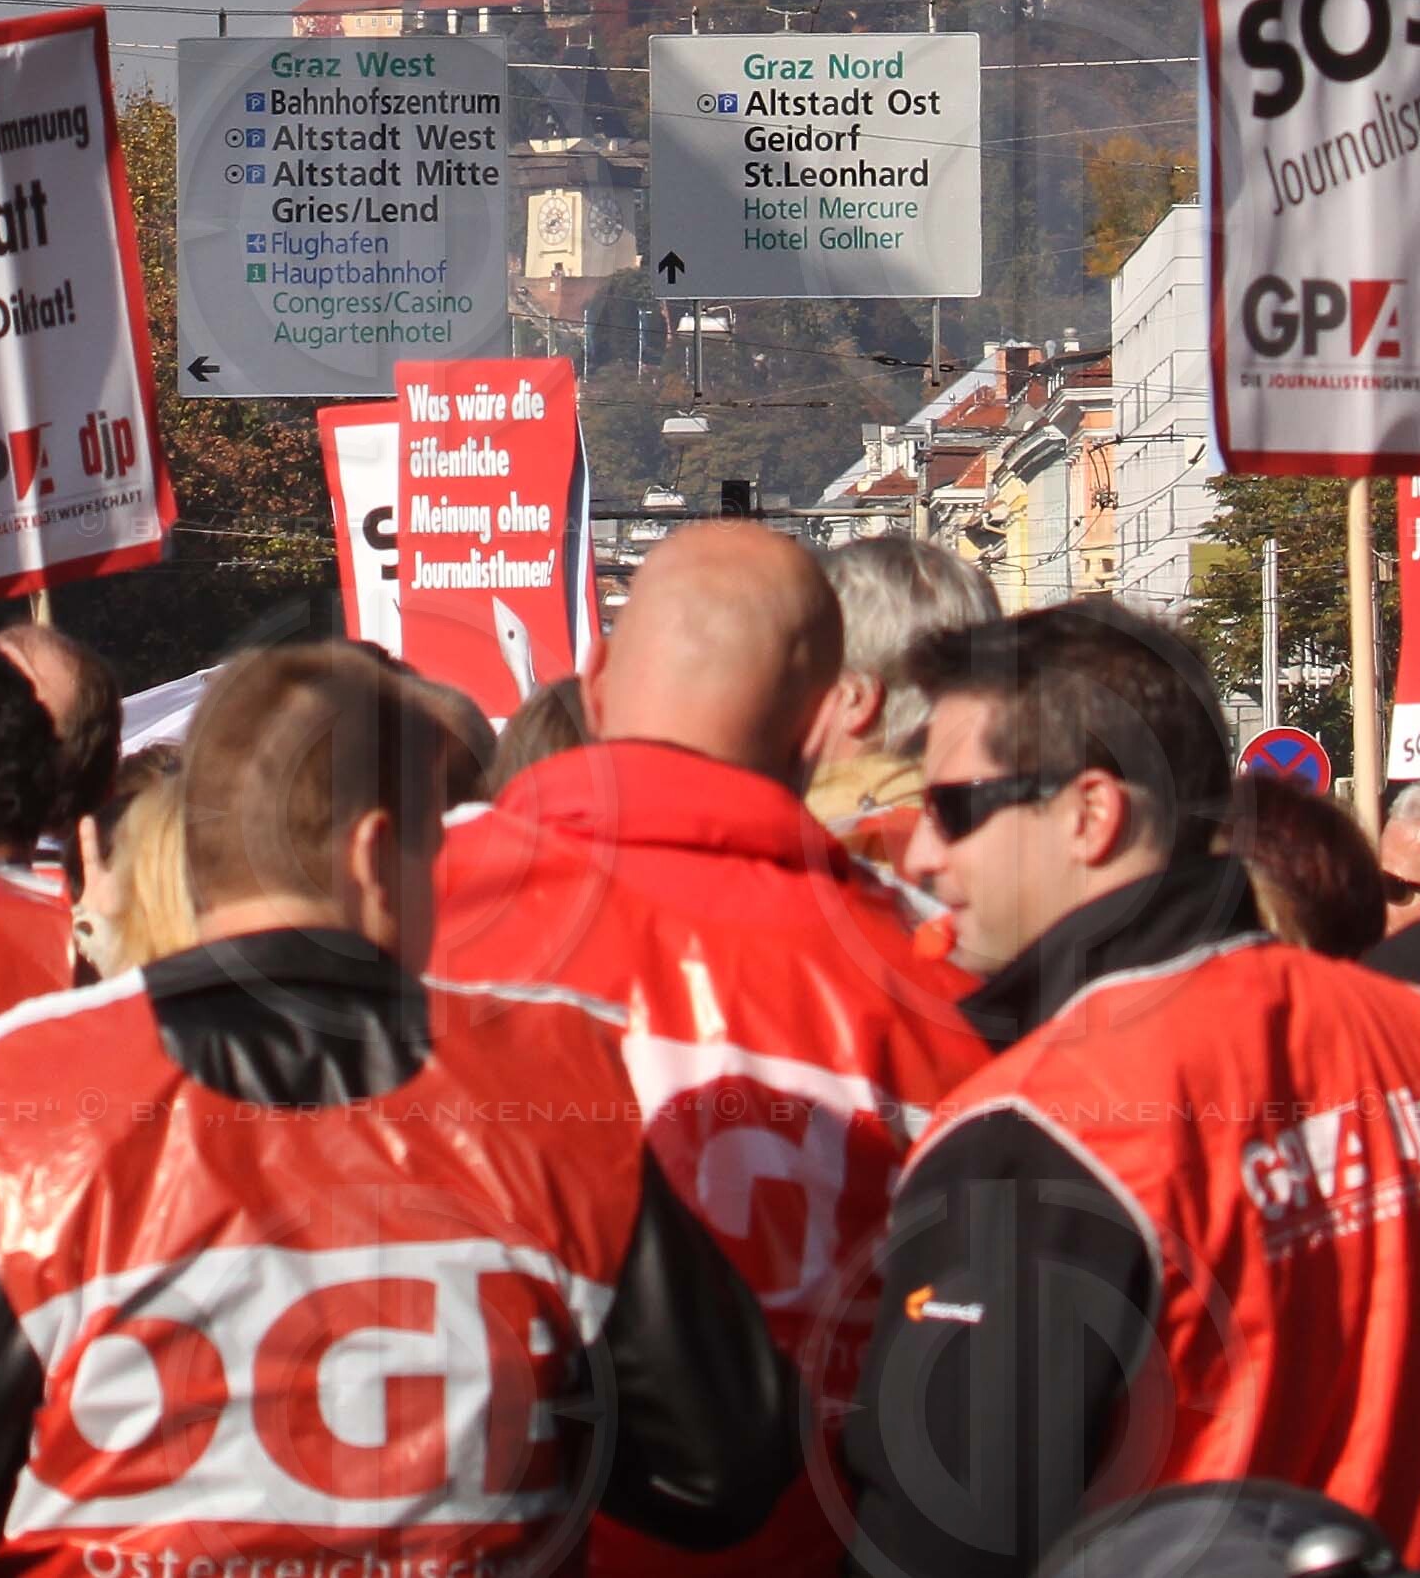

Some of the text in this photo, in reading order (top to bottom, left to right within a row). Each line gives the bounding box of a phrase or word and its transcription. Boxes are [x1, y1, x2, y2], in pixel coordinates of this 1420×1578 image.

[271, 52, 436, 78] Graz West
[744, 51, 904, 80] Graz Nord
[271, 87, 501, 115] Bahnhofszentrum
[745, 88, 941, 116] Altstadt Ost
[272, 123, 496, 151] Altstadt West
[744, 124, 860, 152] Geidorf
[272, 159, 500, 187] Altstadt Mitte
[744, 158, 928, 188] St.Leonhard
[272, 195, 438, 223] Gries/Lend
[744, 196, 918, 220] Hotel Mercure
[271, 231, 388, 260] Flughafen
[744, 226, 904, 250] Hotel Gollner
[272, 260, 447, 289] Hauptbahnhof
[272, 289, 473, 320] Congress/Casino
[274, 320, 451, 349] Augartenhotel
[406, 379, 545, 422] Was wäre die
[409, 435, 510, 478] öffentliche
[411, 495, 491, 544] Meinung
[497, 491, 550, 532] ohne
[411, 548, 556, 589] JournalistInnen?
